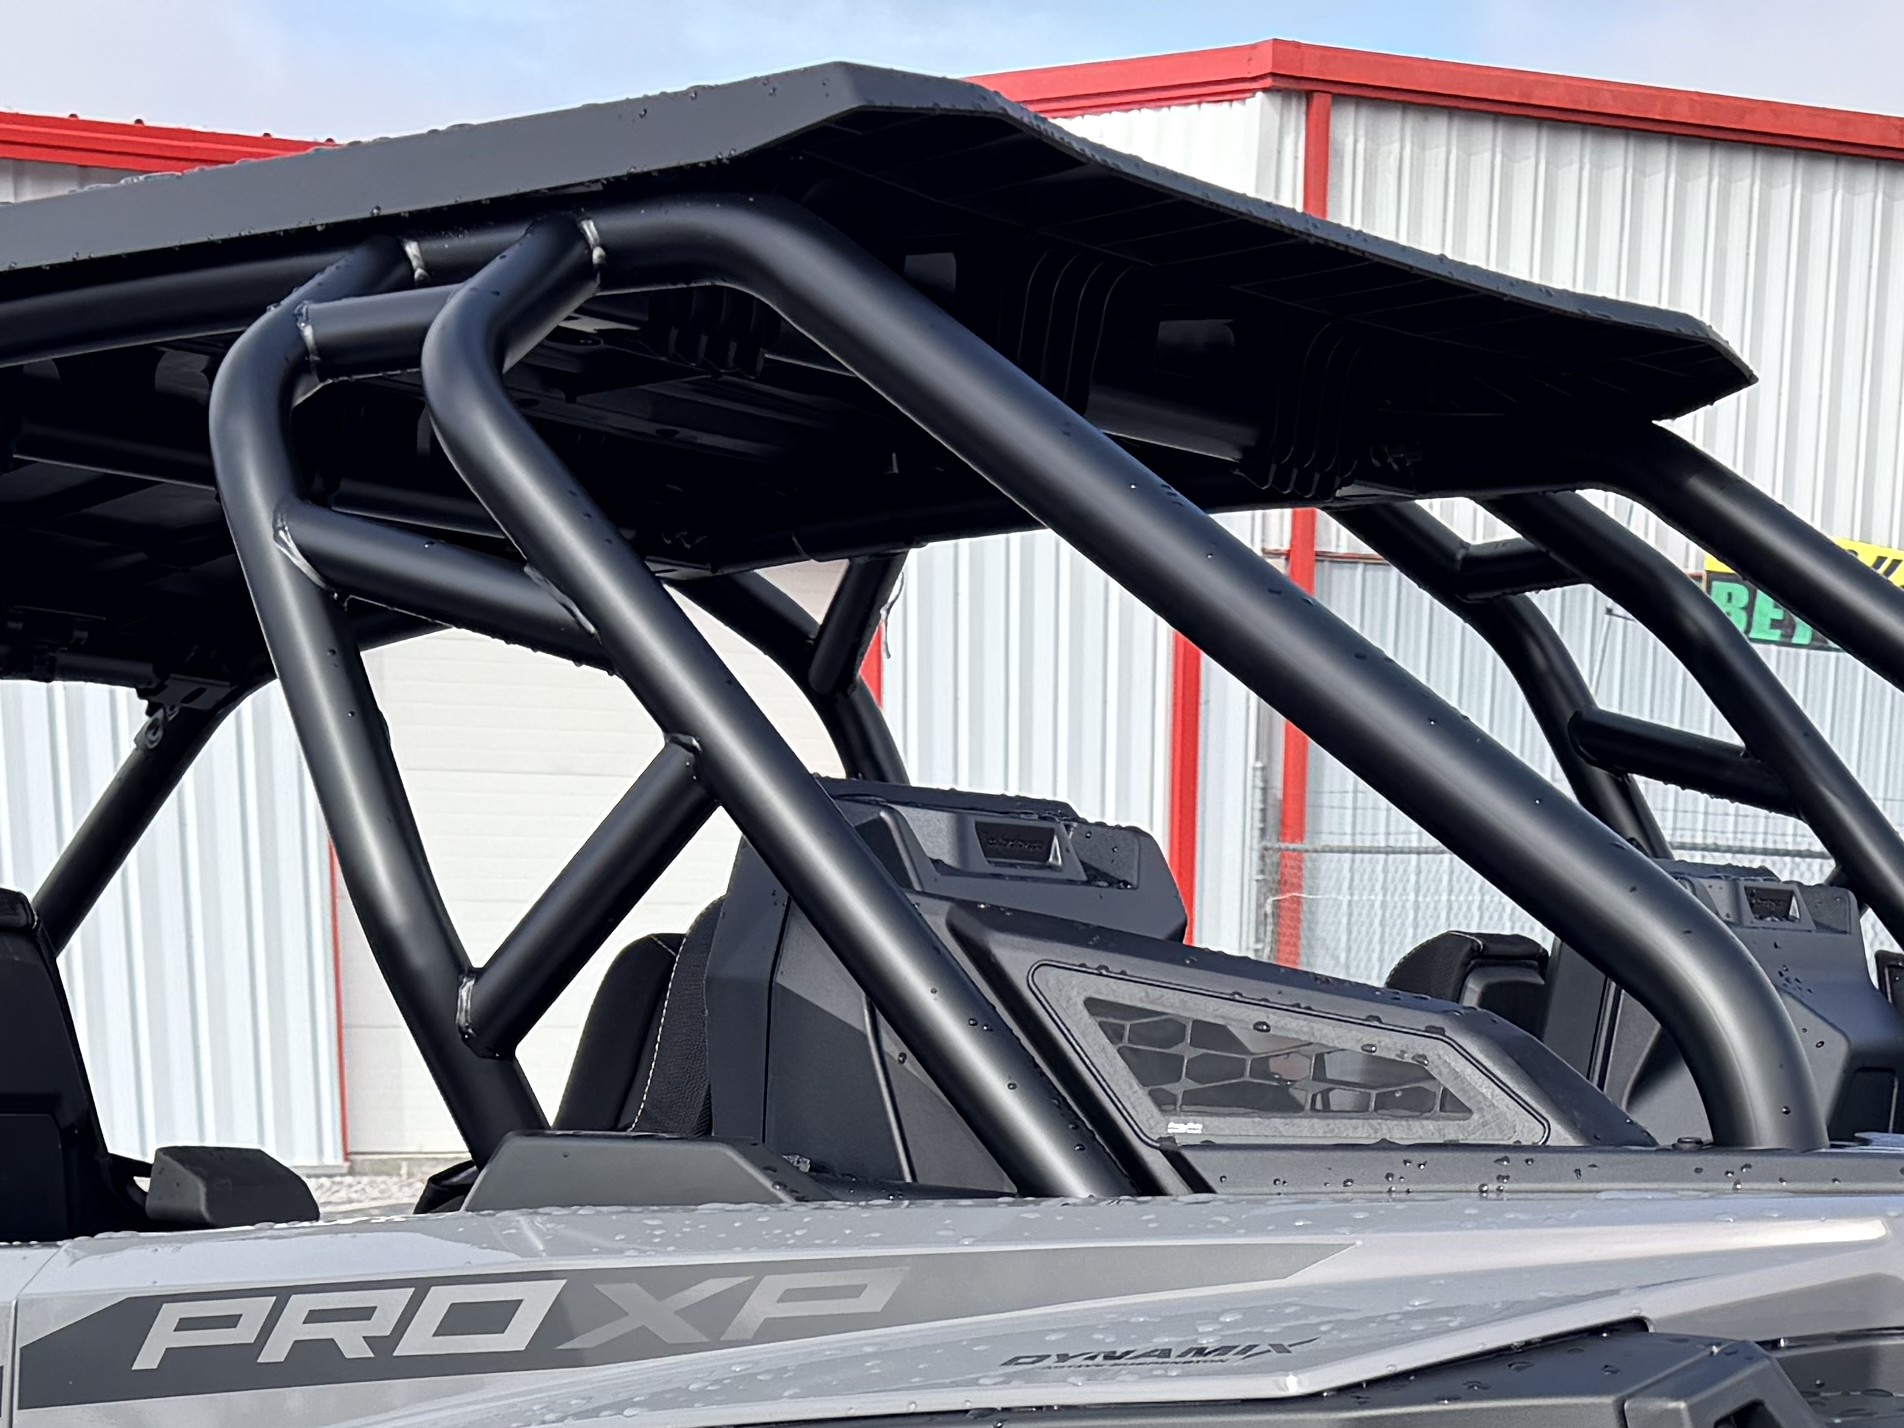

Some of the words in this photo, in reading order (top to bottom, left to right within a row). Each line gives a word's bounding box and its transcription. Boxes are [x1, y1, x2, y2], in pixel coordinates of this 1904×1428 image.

[130, 1278, 568, 1371] PRO
[554, 1266, 913, 1350] XP
[999, 1336, 1322, 1368] DYNAMIX
